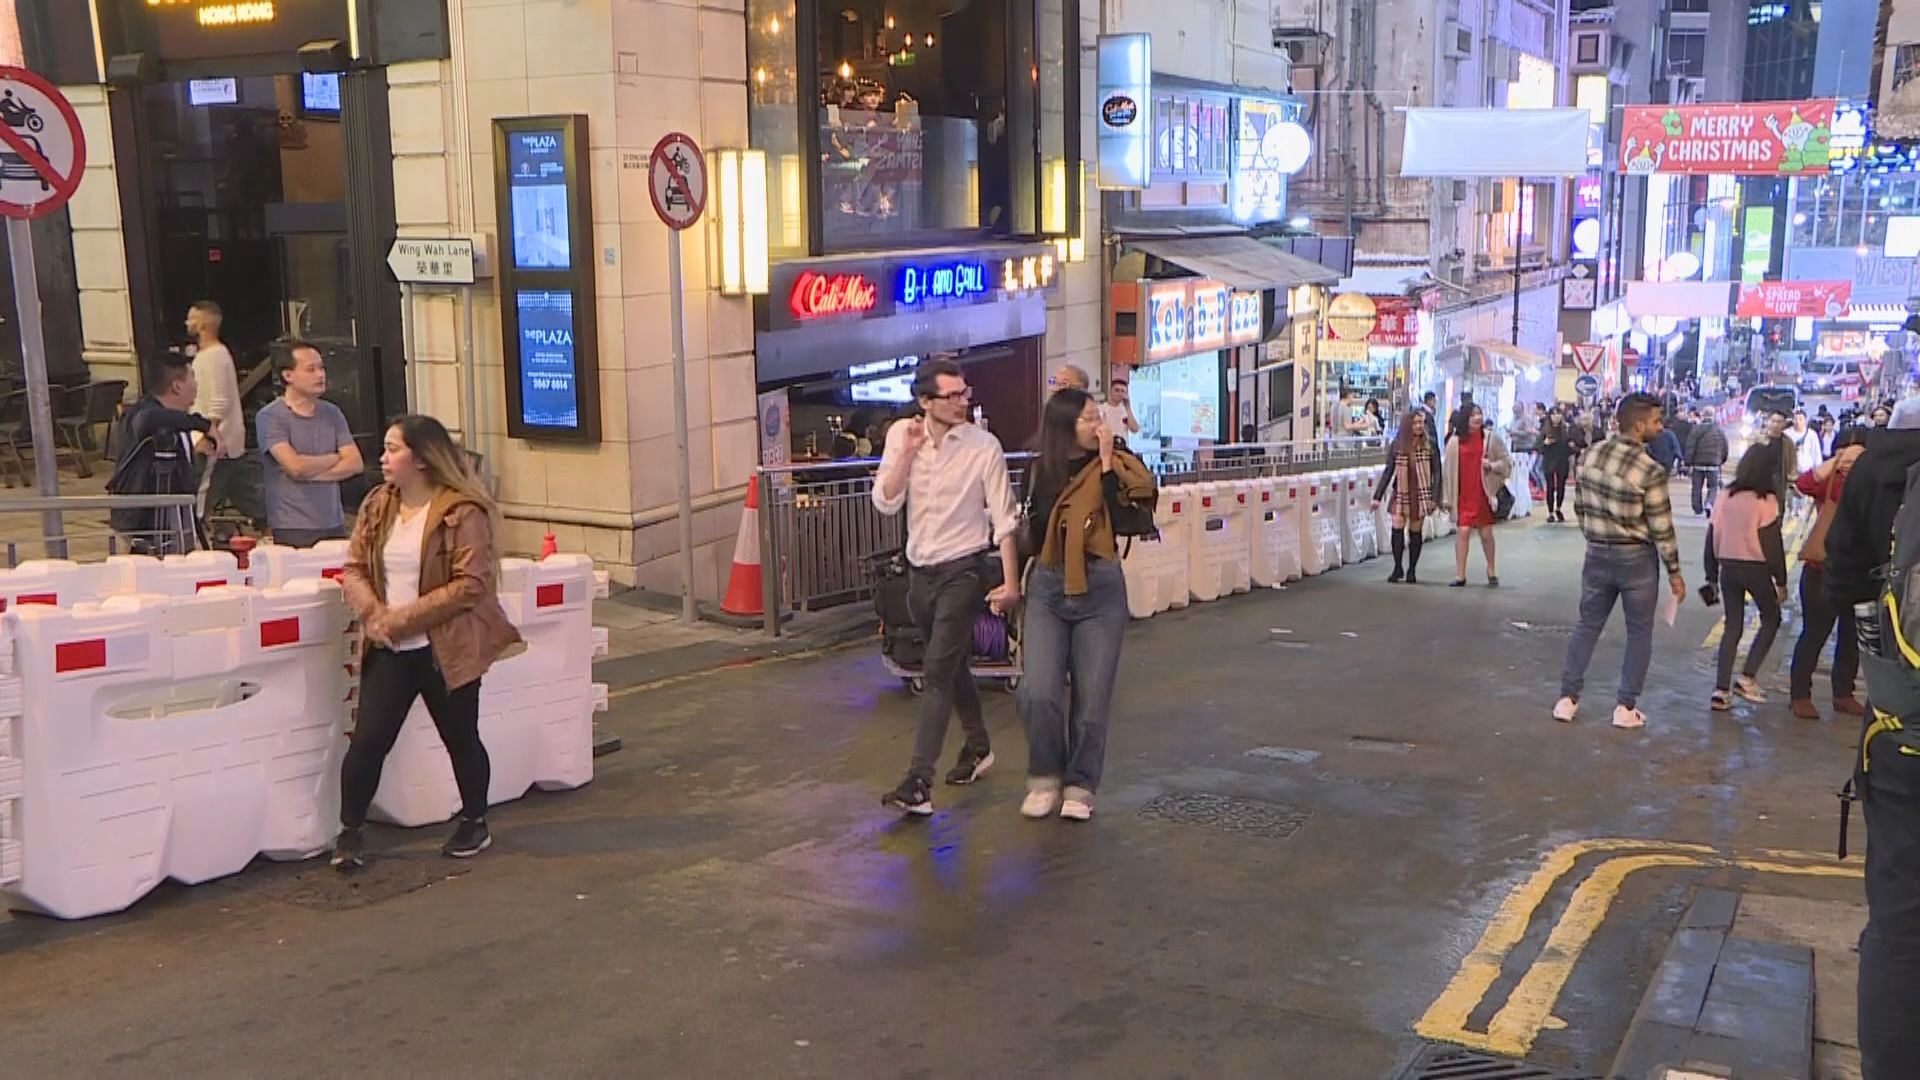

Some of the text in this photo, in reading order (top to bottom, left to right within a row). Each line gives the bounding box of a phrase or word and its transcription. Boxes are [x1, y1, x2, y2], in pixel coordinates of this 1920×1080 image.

[1690, 115, 1754, 138] MERRY
[530, 135, 557, 148] PLAZA
[1668, 139, 1772, 162] CHRISTMAS
[398, 243, 470, 257] Wing Wah Lane
[932, 269, 953, 296] AND
[955, 263, 984, 297] GRILL
[808, 273, 876, 315] Cali-Mex
[1765, 289, 1801, 302] SPREAD
[1216, 287, 1259, 334] Pizza
[1775, 302, 1799, 314] LOVE
[535, 329, 573, 346] PLAZA
[1385, 333, 1407, 344] WAH
